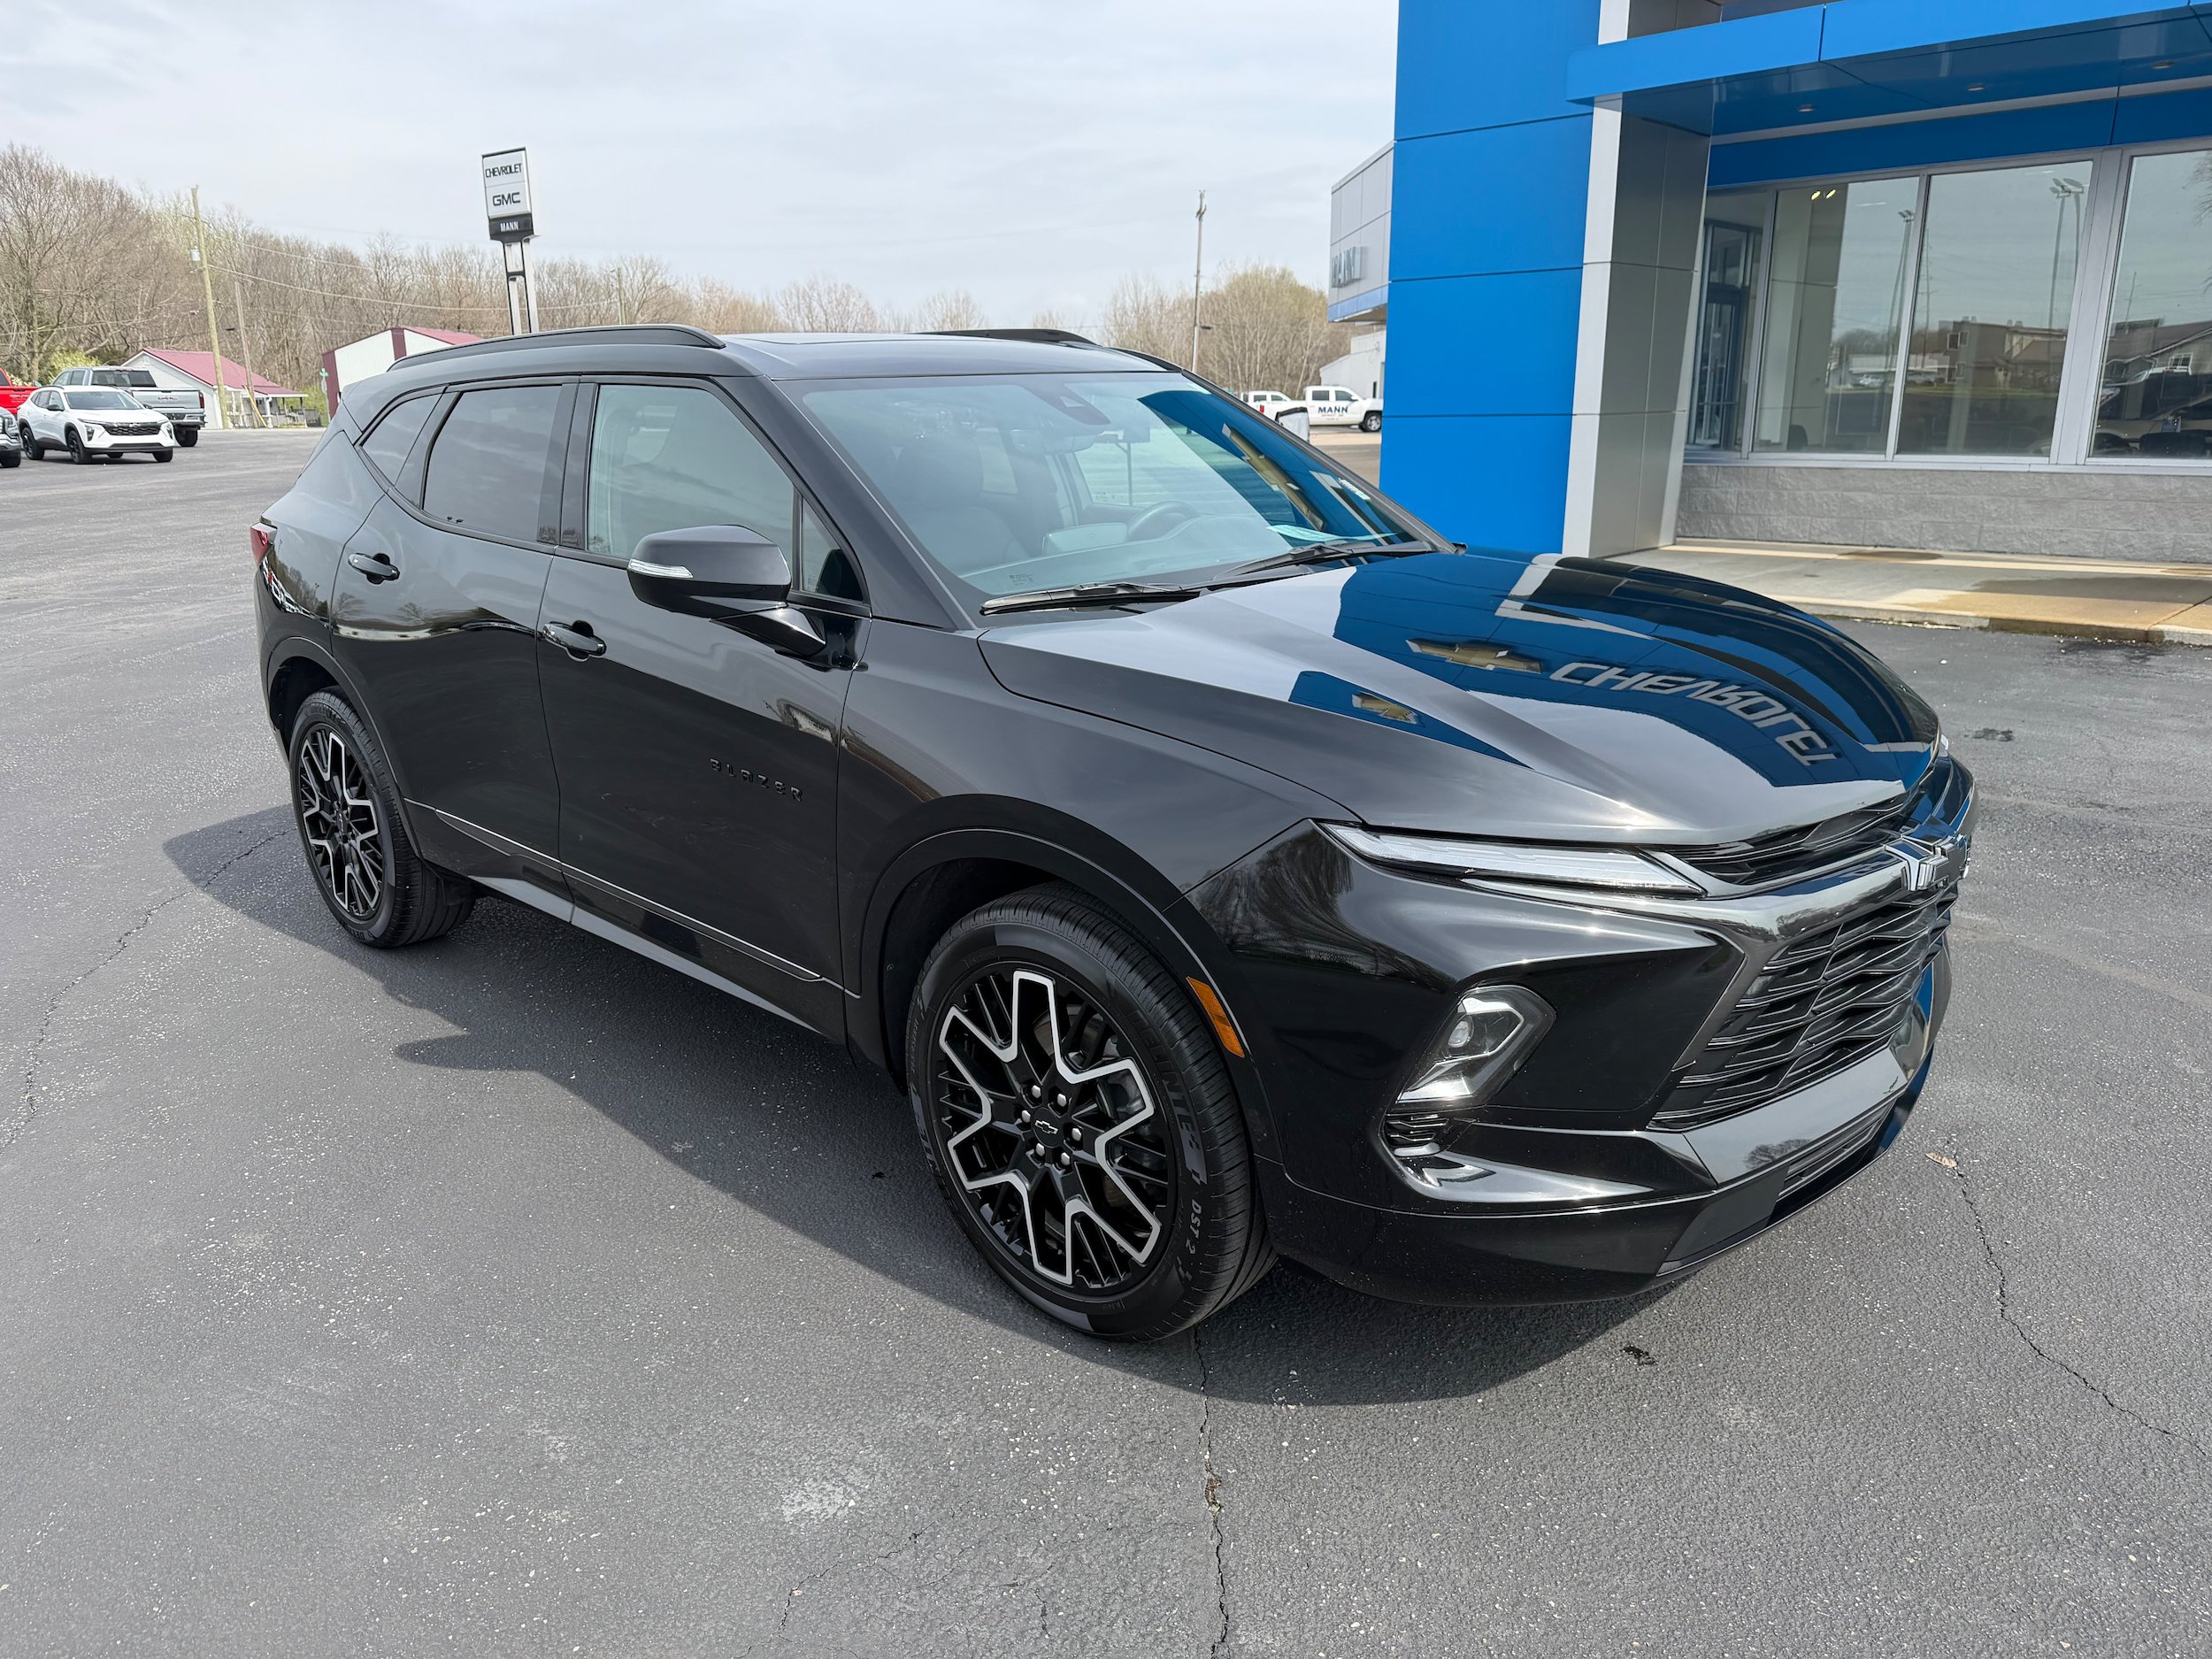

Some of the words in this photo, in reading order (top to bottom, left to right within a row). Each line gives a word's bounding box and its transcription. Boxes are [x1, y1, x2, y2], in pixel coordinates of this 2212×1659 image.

[485, 163, 522, 178] CHEVROLET
[492, 192, 521, 206] GMC
[500, 220, 518, 232] MANN
[1317, 405, 1348, 414] MANN
[710, 757, 803, 802] BLAZER
